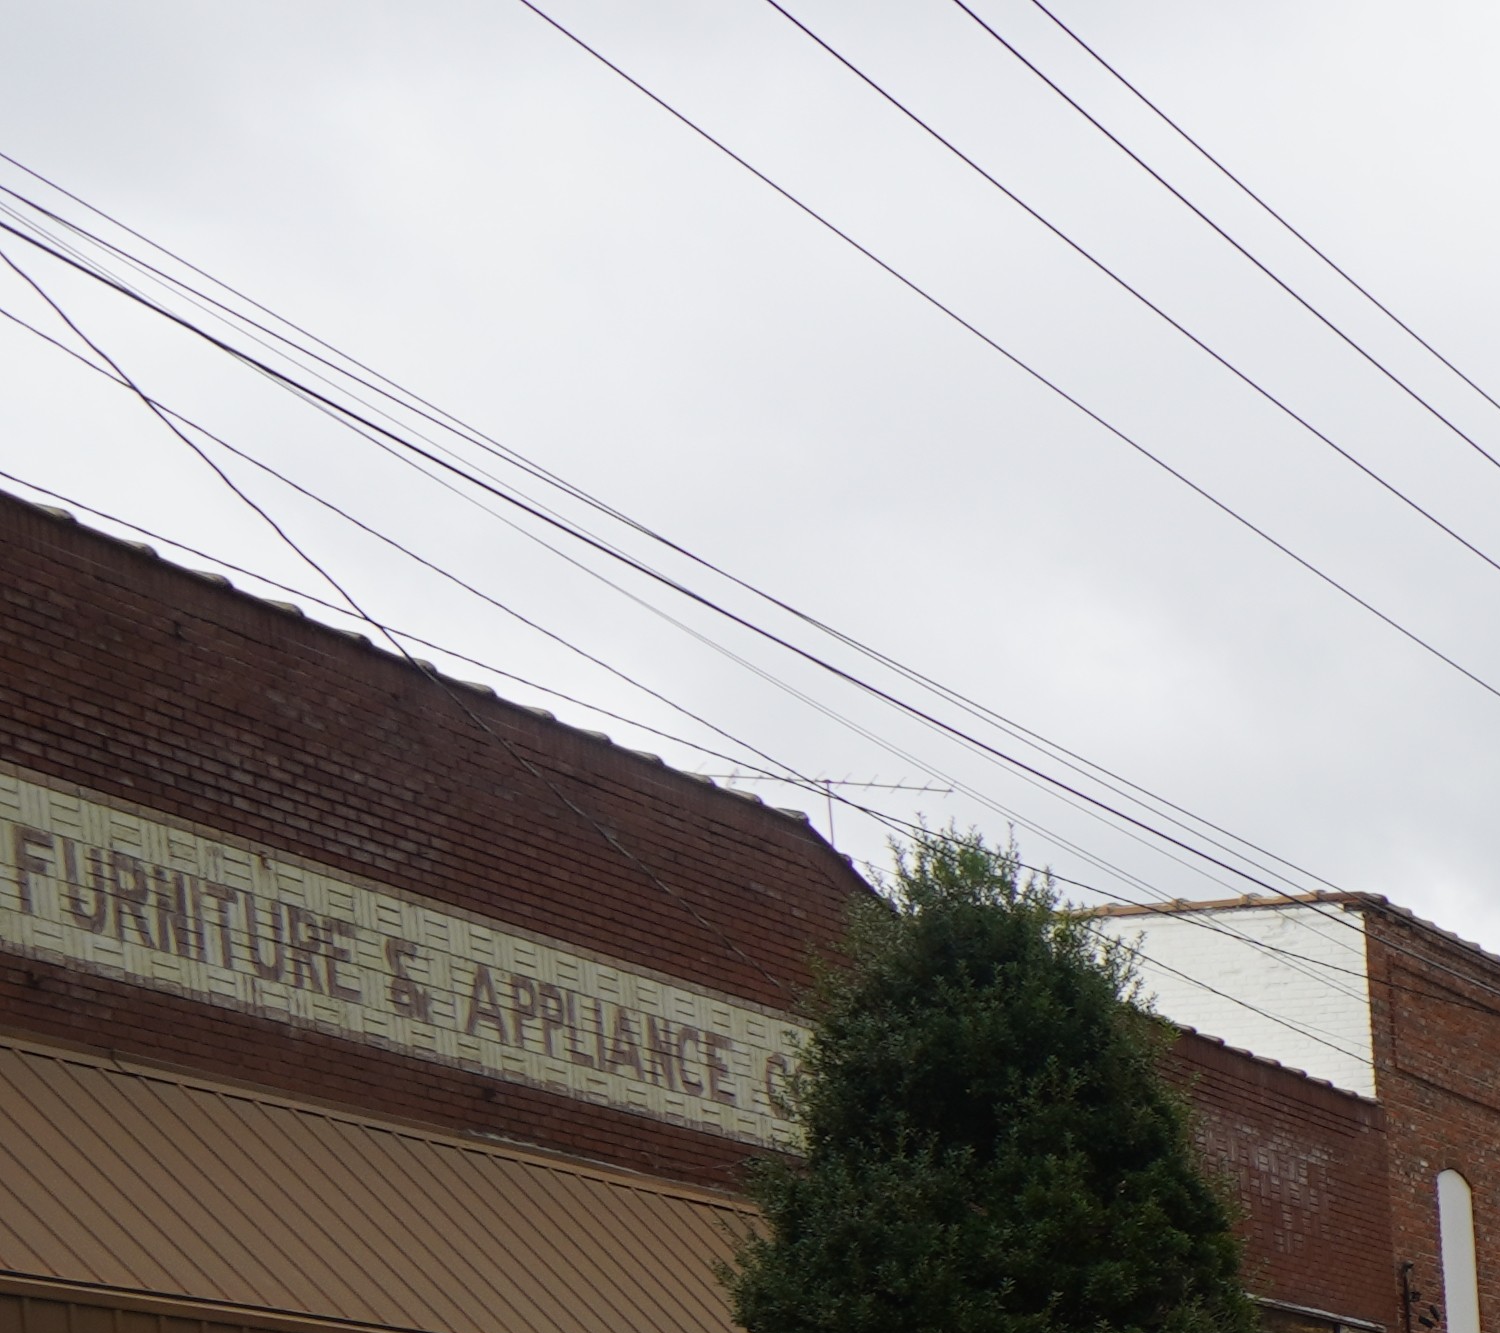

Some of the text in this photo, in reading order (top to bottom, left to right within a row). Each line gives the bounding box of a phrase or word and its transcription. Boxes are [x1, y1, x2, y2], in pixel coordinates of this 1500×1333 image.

[14, 825, 363, 1002] FURNITURE
[385, 938, 433, 1022] &
[466, 962, 738, 1105] APPLIANCE
